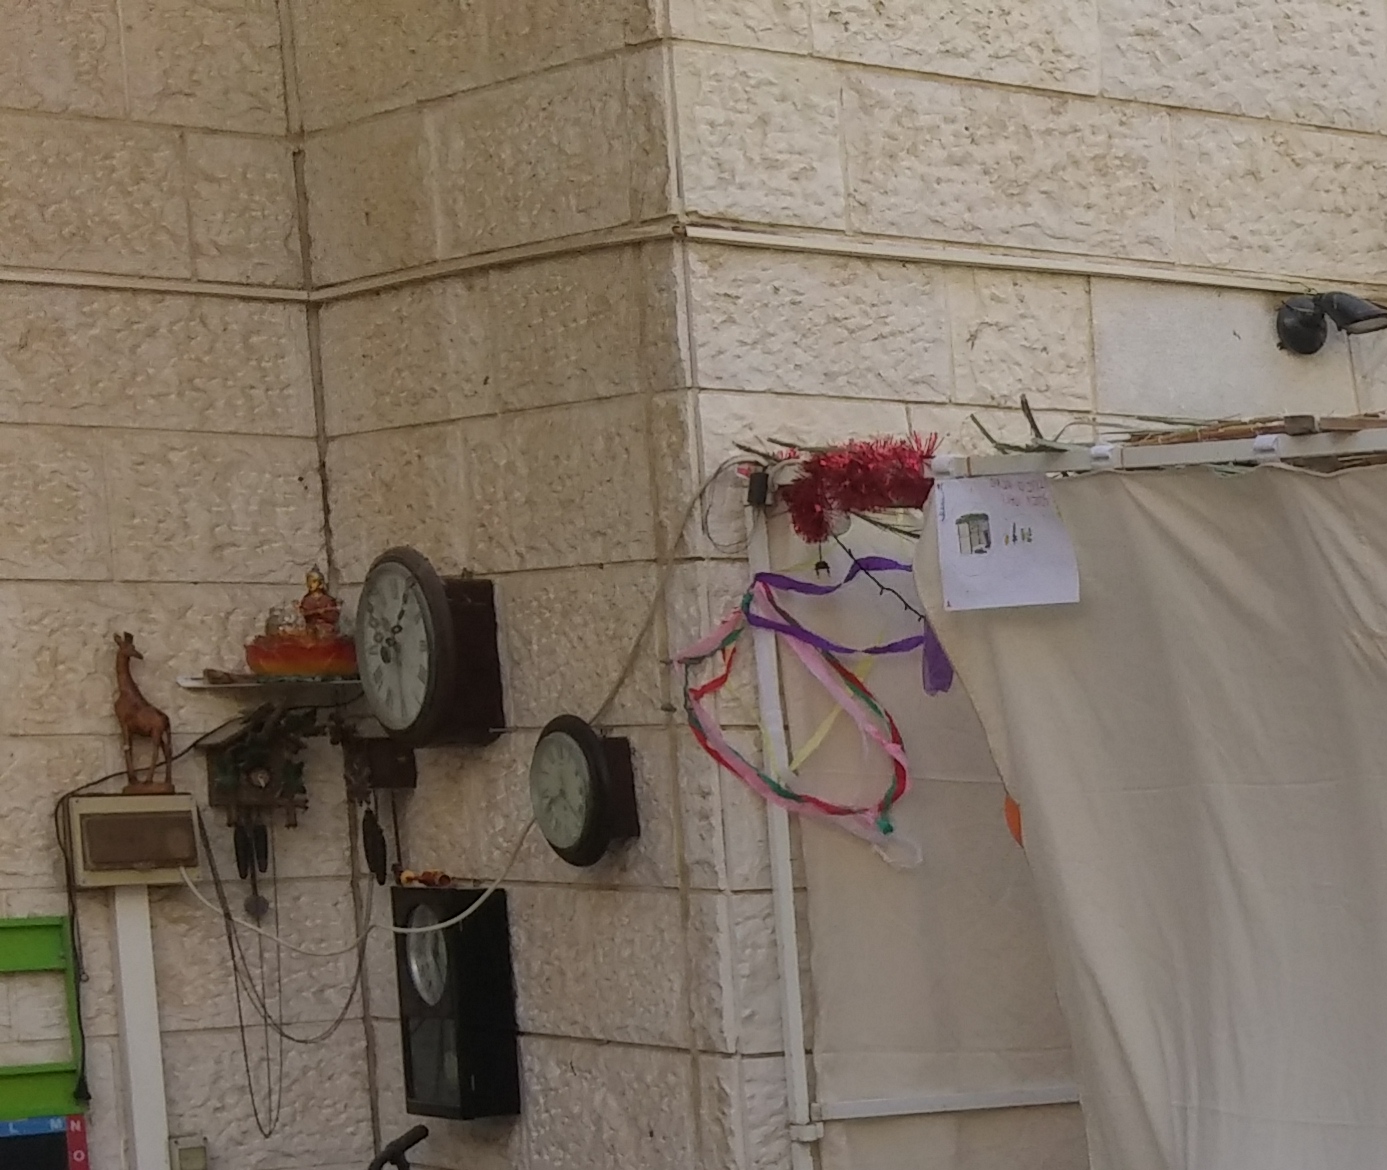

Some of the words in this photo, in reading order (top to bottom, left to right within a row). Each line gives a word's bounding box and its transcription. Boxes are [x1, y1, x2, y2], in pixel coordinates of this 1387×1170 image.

[8, 1122, 19, 1135] L
[49, 1118, 63, 1132] M
[70, 1119, 81, 1132] N
[73, 1149, 86, 1162] O
